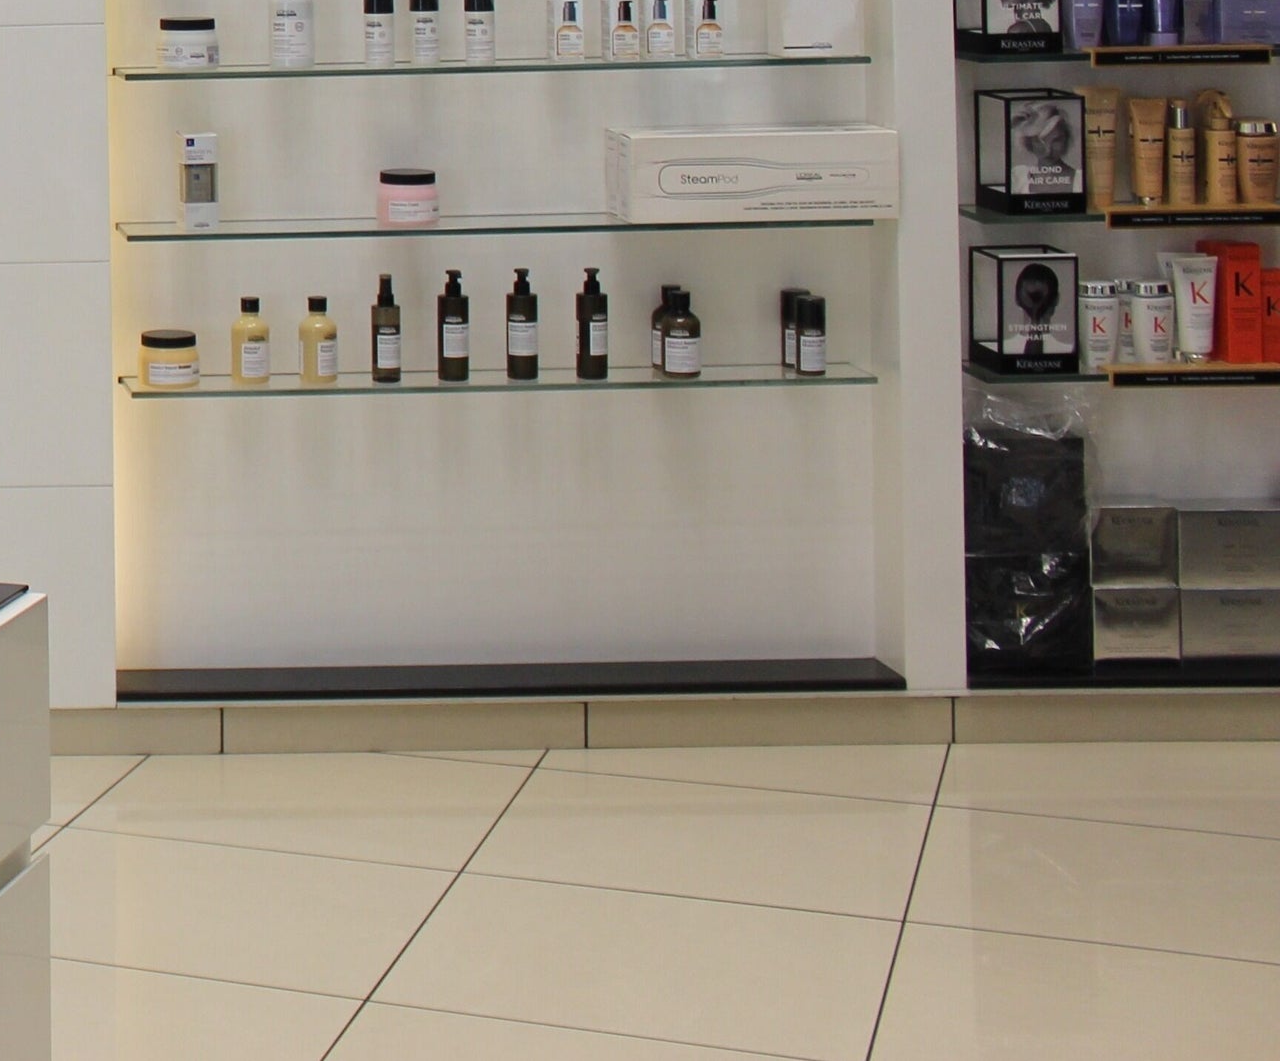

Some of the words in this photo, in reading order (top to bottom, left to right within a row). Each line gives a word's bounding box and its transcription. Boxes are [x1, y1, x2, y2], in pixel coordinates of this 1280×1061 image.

[1023, 12, 1046, 20] CAR
[1030, 166, 1062, 174] BLOND
[680, 174, 739, 185] SteamPod
[1023, 177, 1044, 185] AIR
[1045, 176, 1071, 184] CARE
